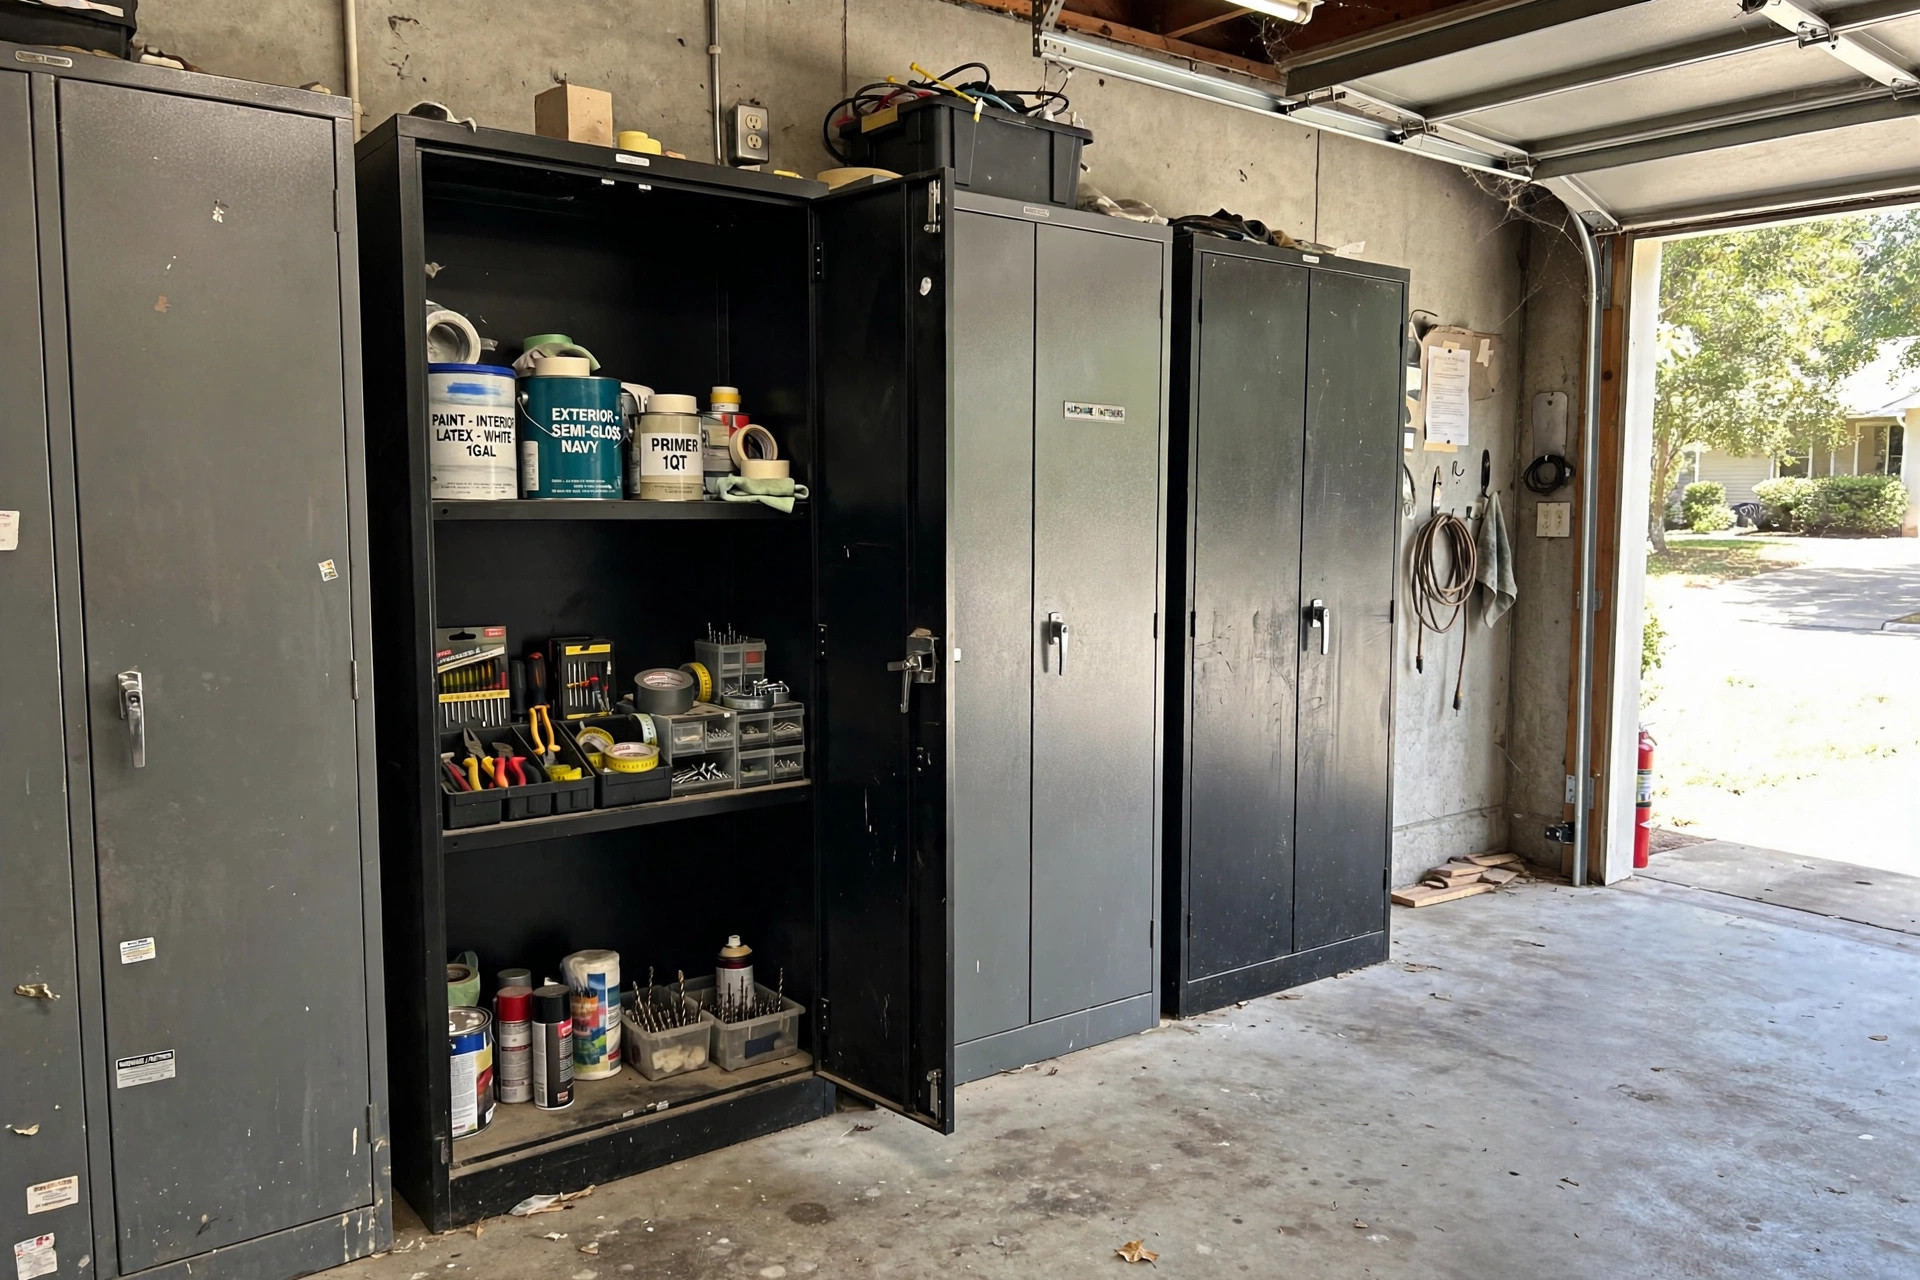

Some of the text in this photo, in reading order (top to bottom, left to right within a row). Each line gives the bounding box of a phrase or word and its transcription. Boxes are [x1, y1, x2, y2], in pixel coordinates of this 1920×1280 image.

[432, 414, 465, 426] PAINT
[436, 429, 473, 442] LATEX
[484, 430, 511, 443] WHITE
[552, 424, 620, 441] SEMI-GLOSS
[466, 444, 496, 457] 1GAL
[561, 440, 598, 453] NAVY
[651, 438, 698, 452] PRIMER
[662, 455, 687, 470] 1QT
